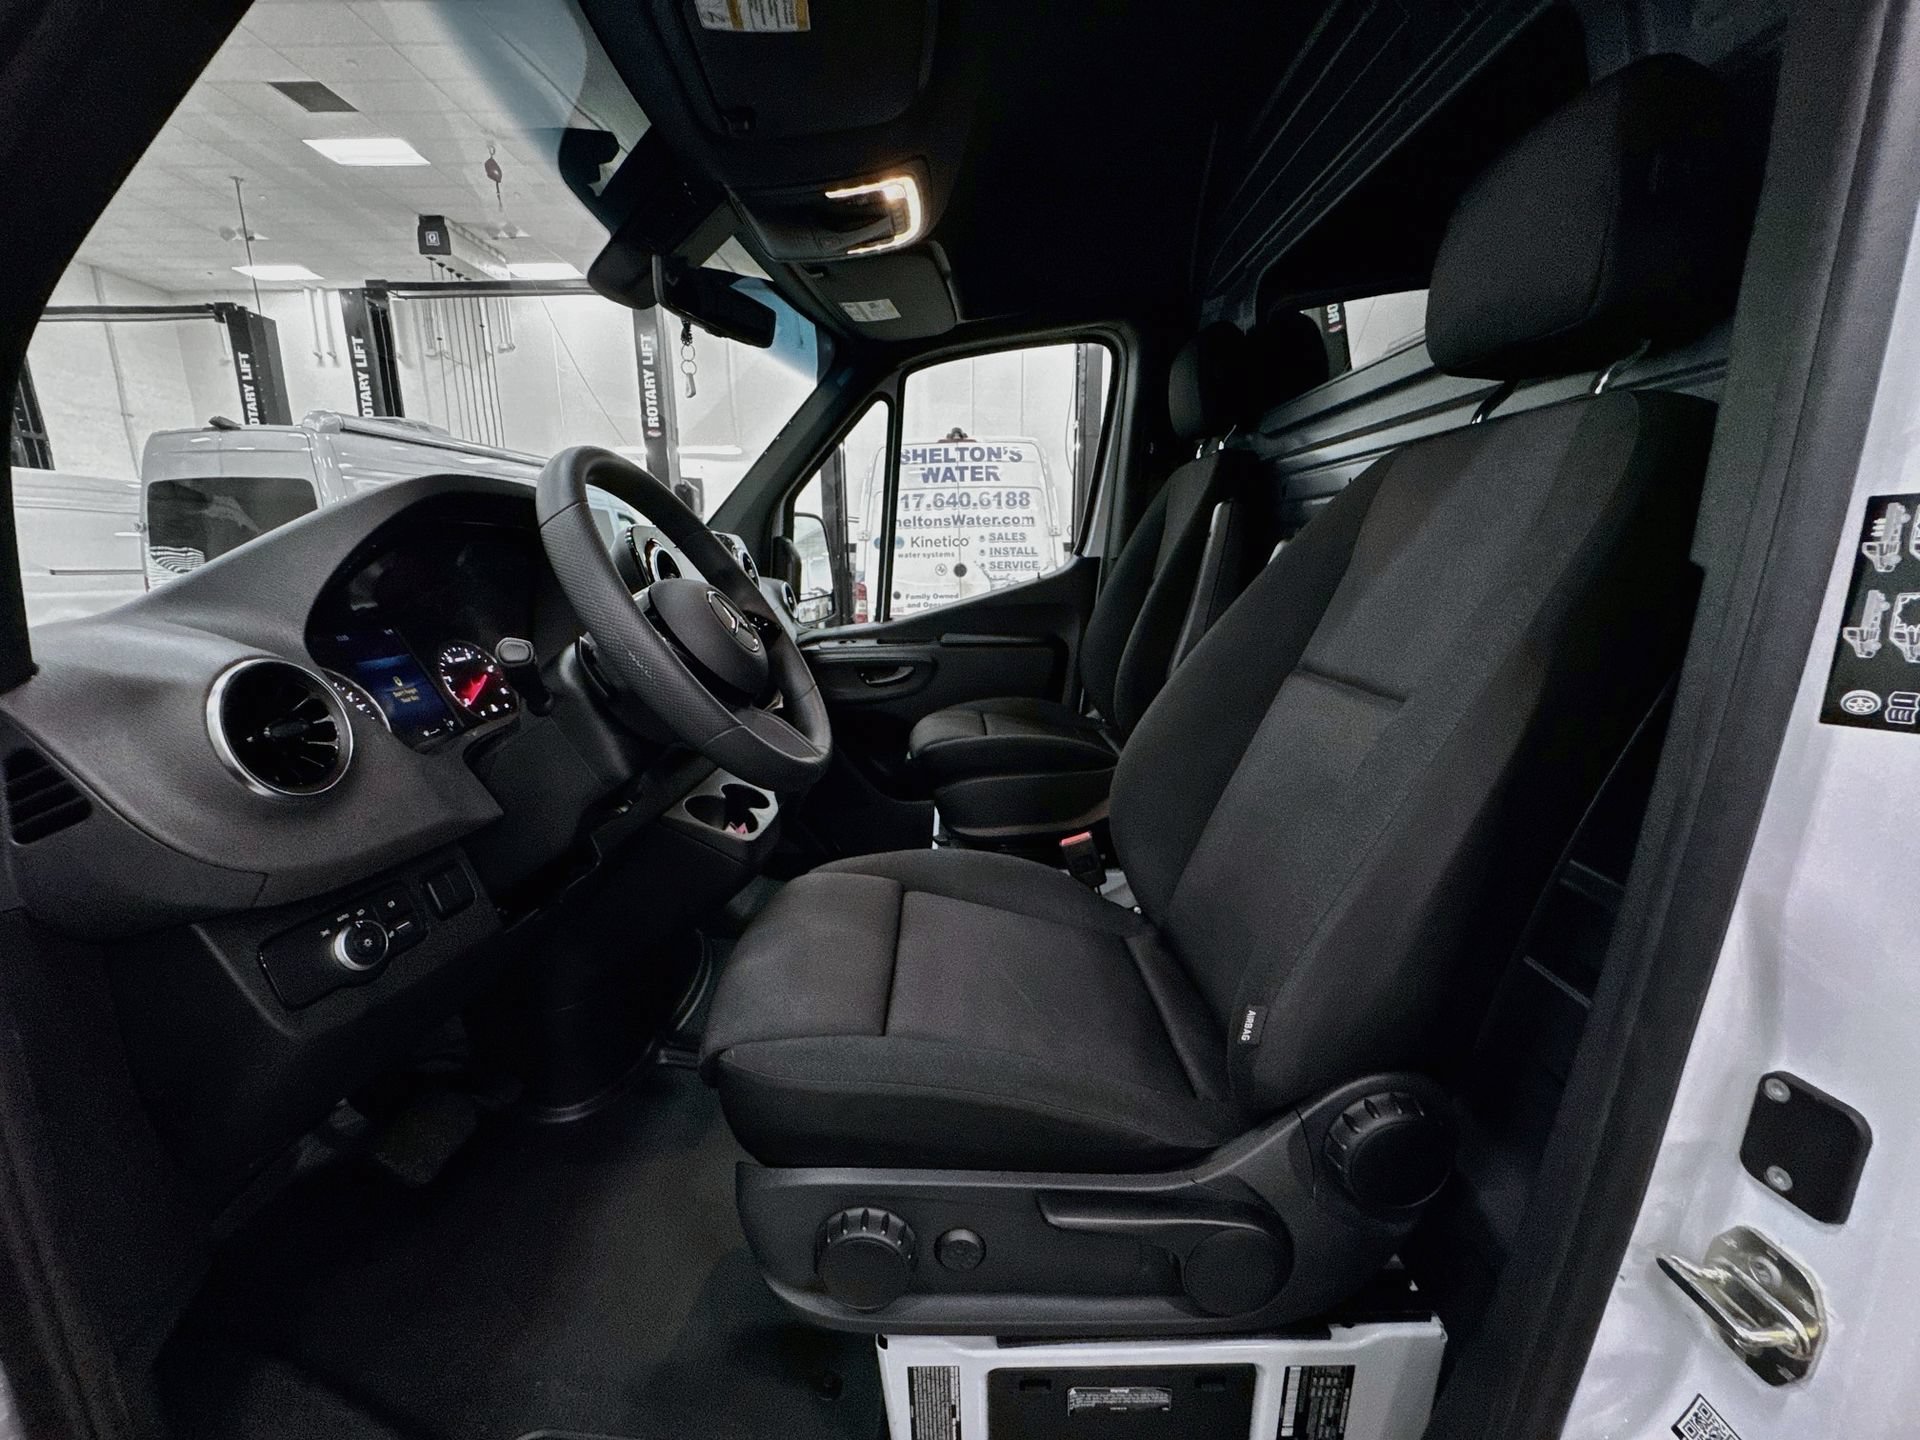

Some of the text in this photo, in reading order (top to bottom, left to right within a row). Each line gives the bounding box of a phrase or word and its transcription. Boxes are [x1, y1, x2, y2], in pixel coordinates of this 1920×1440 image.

[351, 336, 375, 417] OTARY LIFT
[641, 333, 660, 428] ROTARY LIFT
[238, 351, 261, 425] OTARY LIFT
[901, 446, 1023, 464] SHELTON'S
[920, 465, 1001, 483] WATER
[900, 491, 1031, 510] 17.640.6188
[896, 513, 1035, 529] eltonsWater.com
[910, 535, 969, 548] Kinetico
[989, 532, 1026, 542] SALES
[922, 551, 955, 559] systems
[989, 546, 1038, 556] INSTALL
[989, 560, 1039, 570] SERVICE
[905, 592, 959, 601] Family Owned
[1241, 1010, 1257, 1041] AIRBAG
